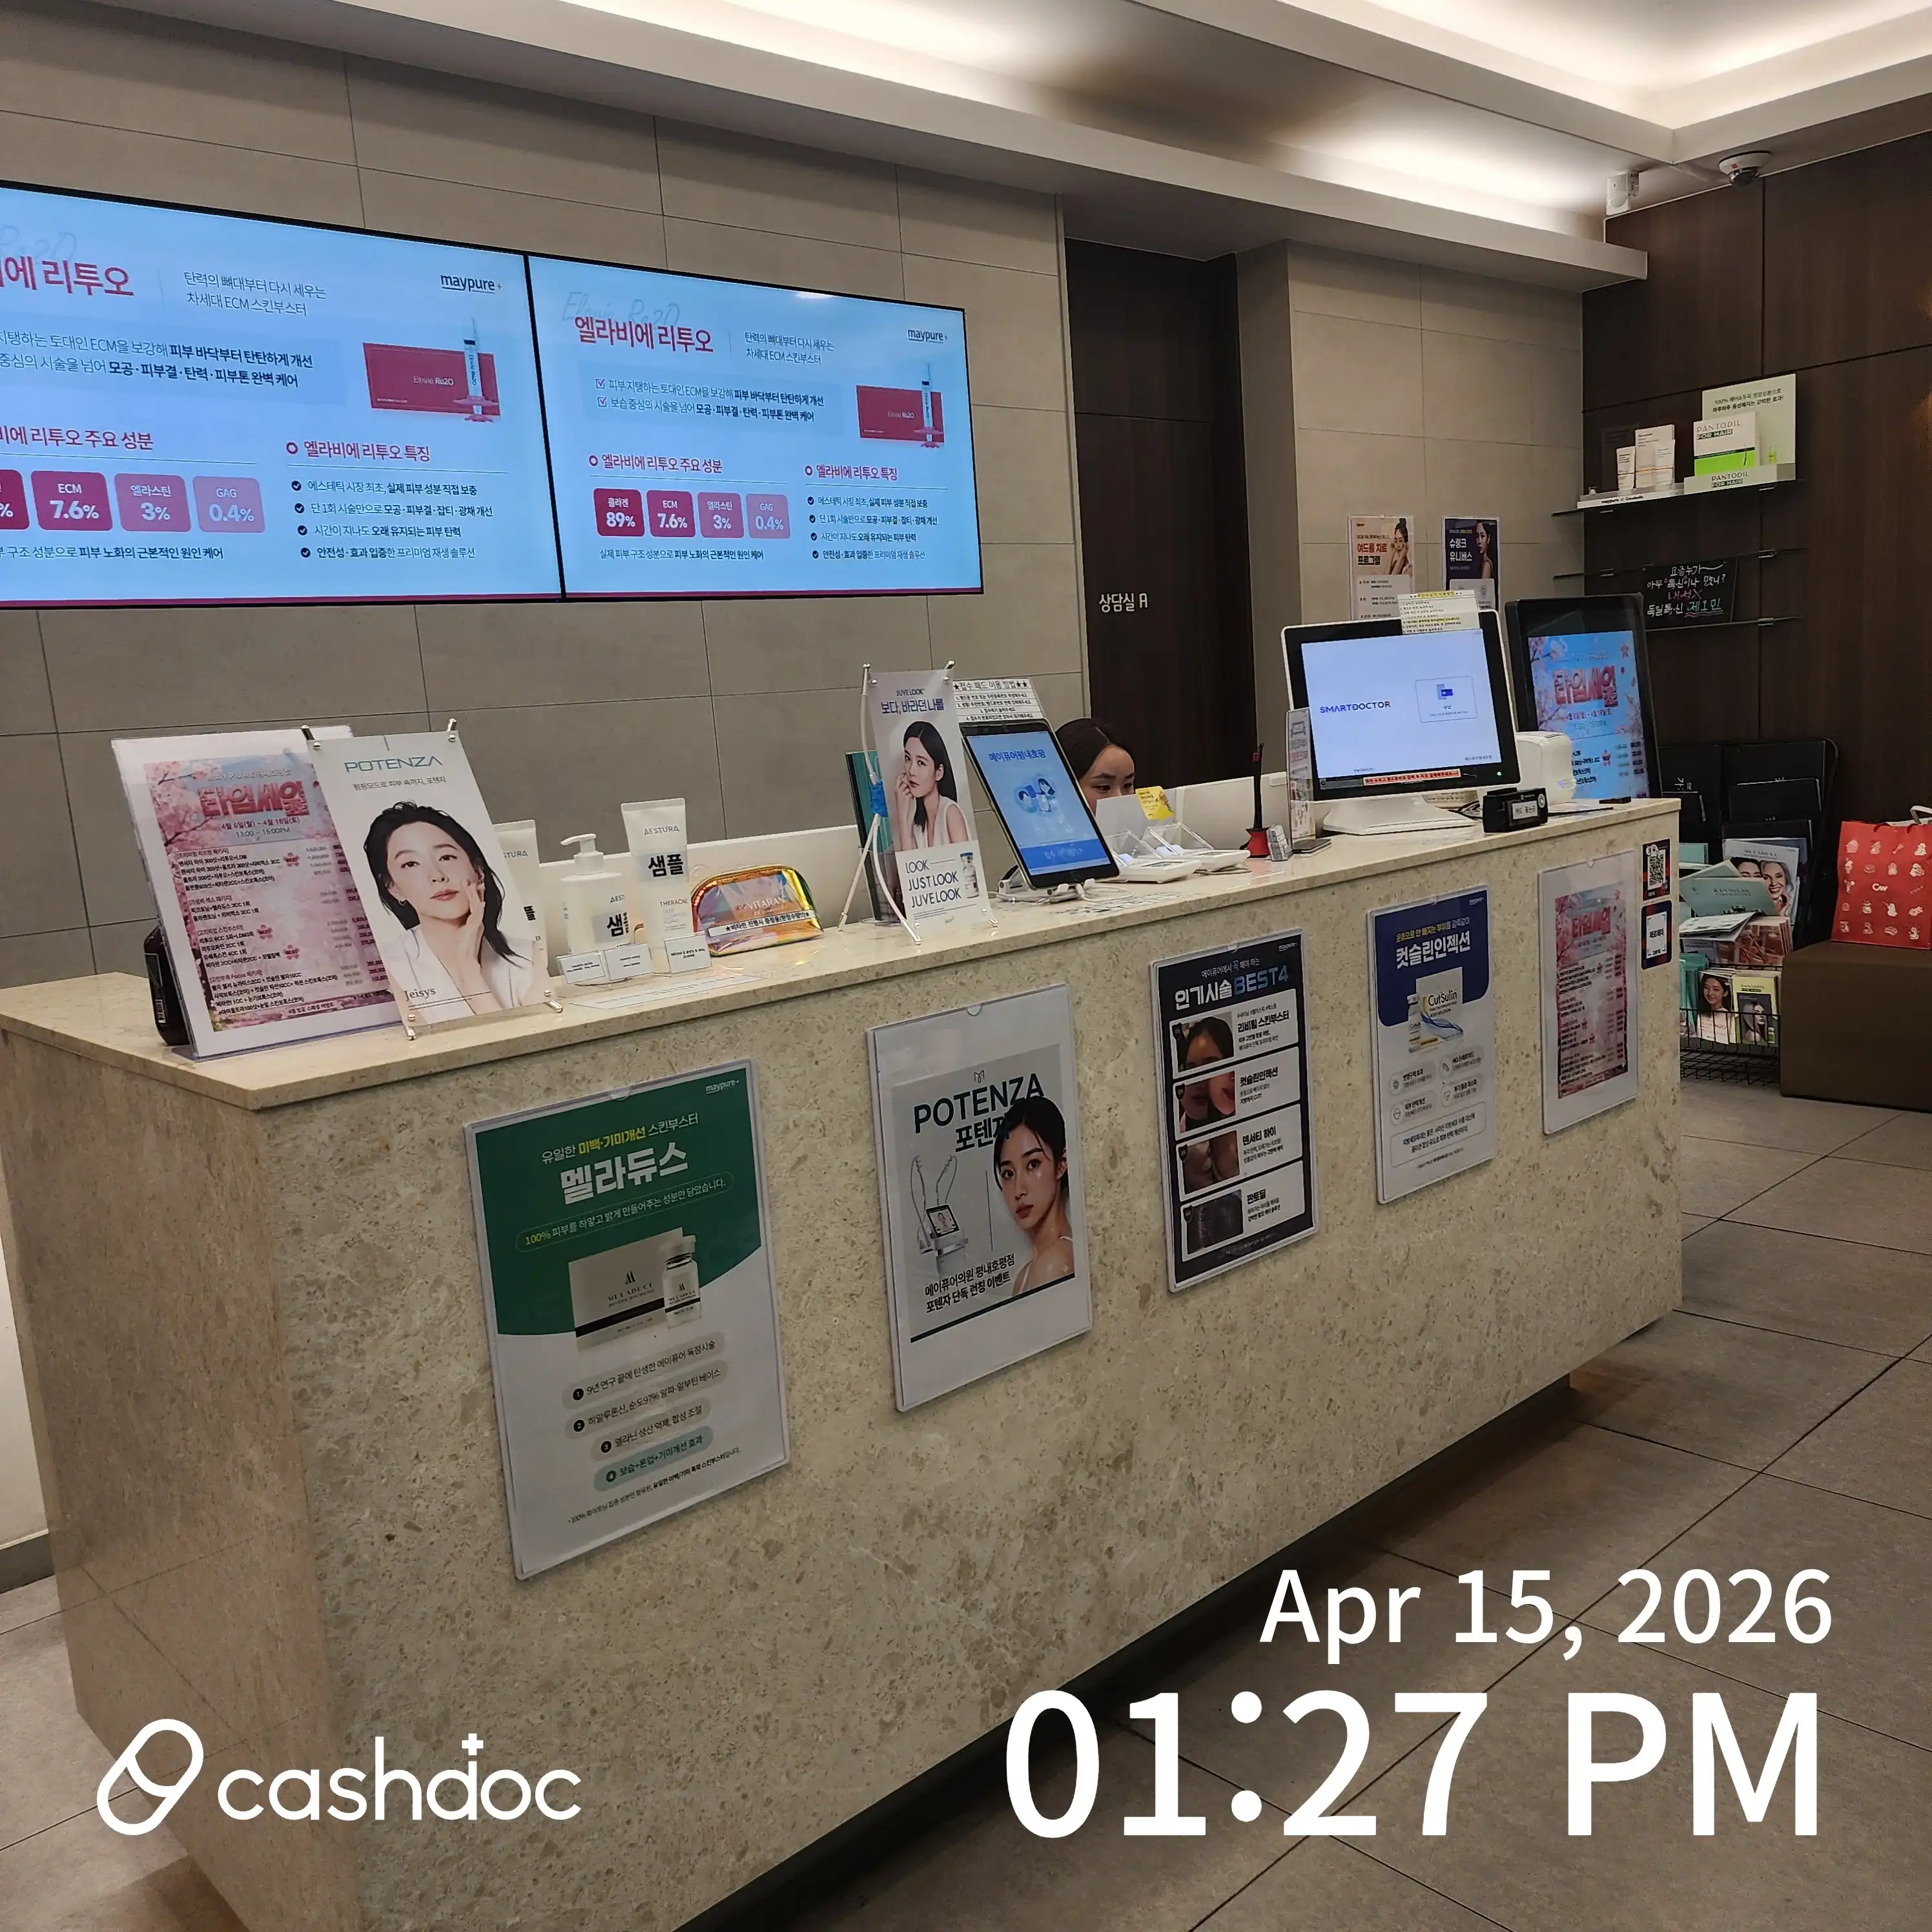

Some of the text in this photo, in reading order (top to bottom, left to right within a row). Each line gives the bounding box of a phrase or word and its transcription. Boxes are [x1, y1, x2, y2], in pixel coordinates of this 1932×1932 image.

[41, 258, 134, 300] 리투오
[183, 270, 219, 289] 탄력의
[269, 279, 291, 296] 다시
[293, 282, 326, 300] 세우는
[440, 272, 495, 294] maypure
[187, 291, 307, 317] 차세대 ECM 스킨부스터
[573, 315, 714, 355] 엘라비에 리투오
[907, 327, 943, 344] maypure
[1697, 420, 1741, 433] PANTODIL
[1714, 429, 1732, 437] HAIR
[30, 427, 154, 451] 리투오 주요 성분
[303, 440, 430, 462] 엘라비에 리투오 특징
[601, 453, 723, 473] 엘라비에 리투오 주요 성분
[816, 464, 898, 481] 엘라비에 리투오 특징
[1711, 472, 1749, 481] PANTODIL
[57, 483, 82, 494] ECM
[130, 484, 171, 497] 엘라스틴
[216, 488, 236, 498] GAG
[50, 500, 99, 519] 7.6%
[141, 502, 170, 520] 3%
[663, 500, 678, 508] ECM
[759, 502, 773, 511] GAG
[209, 504, 254, 522] 0.4%
[605, 511, 635, 528] 89%
[657, 513, 687, 528] 7.6%
[713, 514, 732, 529] 3%
[755, 515, 784, 530] 0.4%
[1357, 542, 1387, 553] 여드름 치료
[1450, 538, 1466, 549] 슈링크
[7, 546, 223, 559] 구조 성분으로 피부 노화의 근본적인 원인 케어
[1358, 555, 1381, 565] 프로그램
[1450, 551, 1472, 562] 유니버스
[1098, 593, 1147, 613] 상담실 A
[1687, 599, 1721, 611] 제오민
[1554, 666, 1618, 707] 타임세일
[881, 701, 901, 715] 보다,
[1320, 701, 1391, 714] SMARTDOCTOR
[343, 755, 443, 773] POTENZA
[387, 779, 404, 788] 피부
[197, 781, 309, 817] 타임세일
[644, 825, 680, 836] AESTURA
[648, 853, 684, 878] 샘플
[905, 859, 929, 874] LOOK
[1572, 906, 1612, 938] 타임세일
[1395, 930, 1470, 969] 컷슬린인젝션
[402, 985, 437, 1001] Jeisys
[1174, 978, 1232, 1011] 인기시술
[1233, 963, 1289, 996] BEST4
[1428, 987, 1457, 1007] CutSulin
[705, 1078, 735, 1095] maypure
[912, 1070, 1045, 1135] POTENZA
[541, 1143, 577, 1165] 유일한
[647, 1111, 699, 1137] 스킨부스터
[1263, 1125, 1276, 1139] 하이
[559, 1137, 688, 1206] 멜라듀스
[524, 1228, 551, 1246] 100%
[551, 1220, 577, 1238] 피부를
[604, 1207, 621, 1222] 밝게
[622, 1195, 662, 1217] 만들어주는
[663, 1189, 685, 1206] 성분만
[924, 1252, 1015, 1298] 메이퓨어의원 평내호평점
[925, 1269, 1011, 1314] 포텐자 단독 런칭 이벤트
